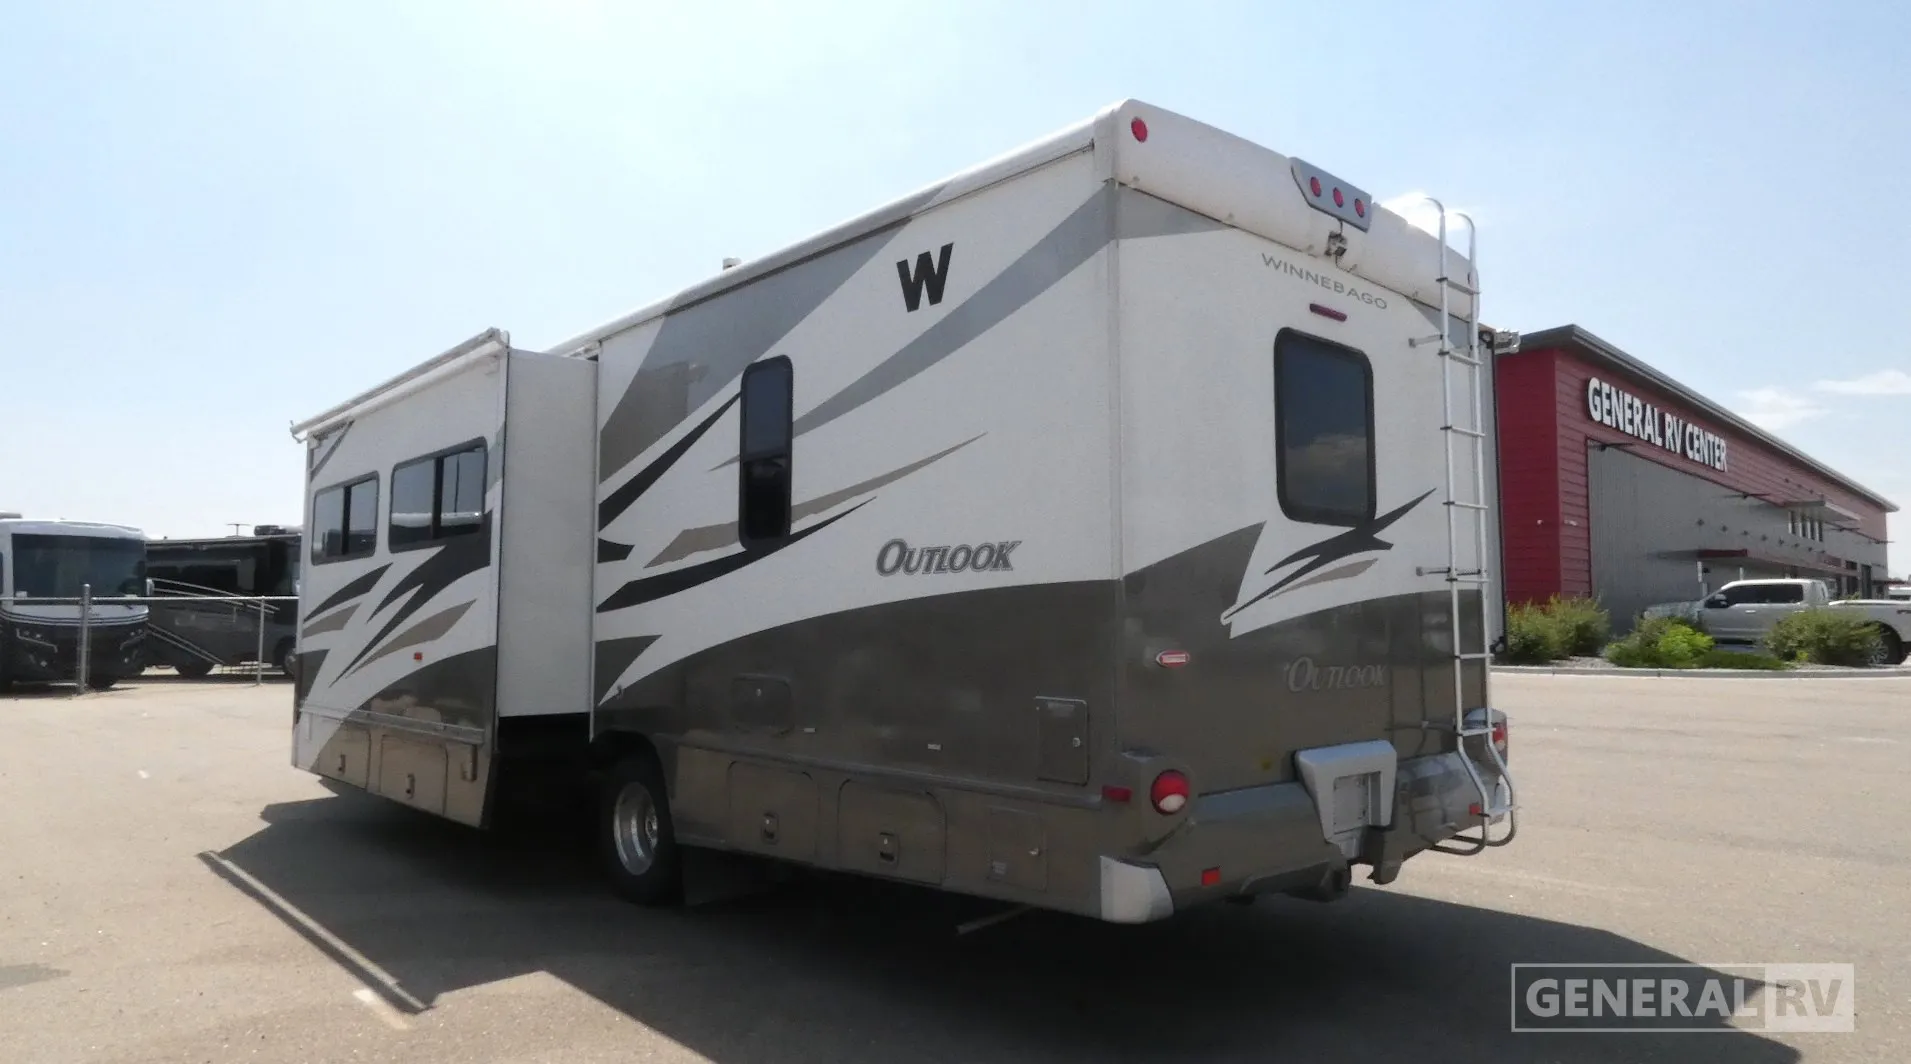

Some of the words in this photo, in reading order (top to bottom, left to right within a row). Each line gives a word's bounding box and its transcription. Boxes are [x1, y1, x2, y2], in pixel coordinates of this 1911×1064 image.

[897, 243, 953, 312] W
[1261, 252, 1388, 310] WINNEBAGO
[1588, 377, 1663, 447] GENERAL
[1664, 412, 1682, 454] RV
[1685, 422, 1728, 473] CENTER
[876, 538, 1022, 577] OUTLOOK
